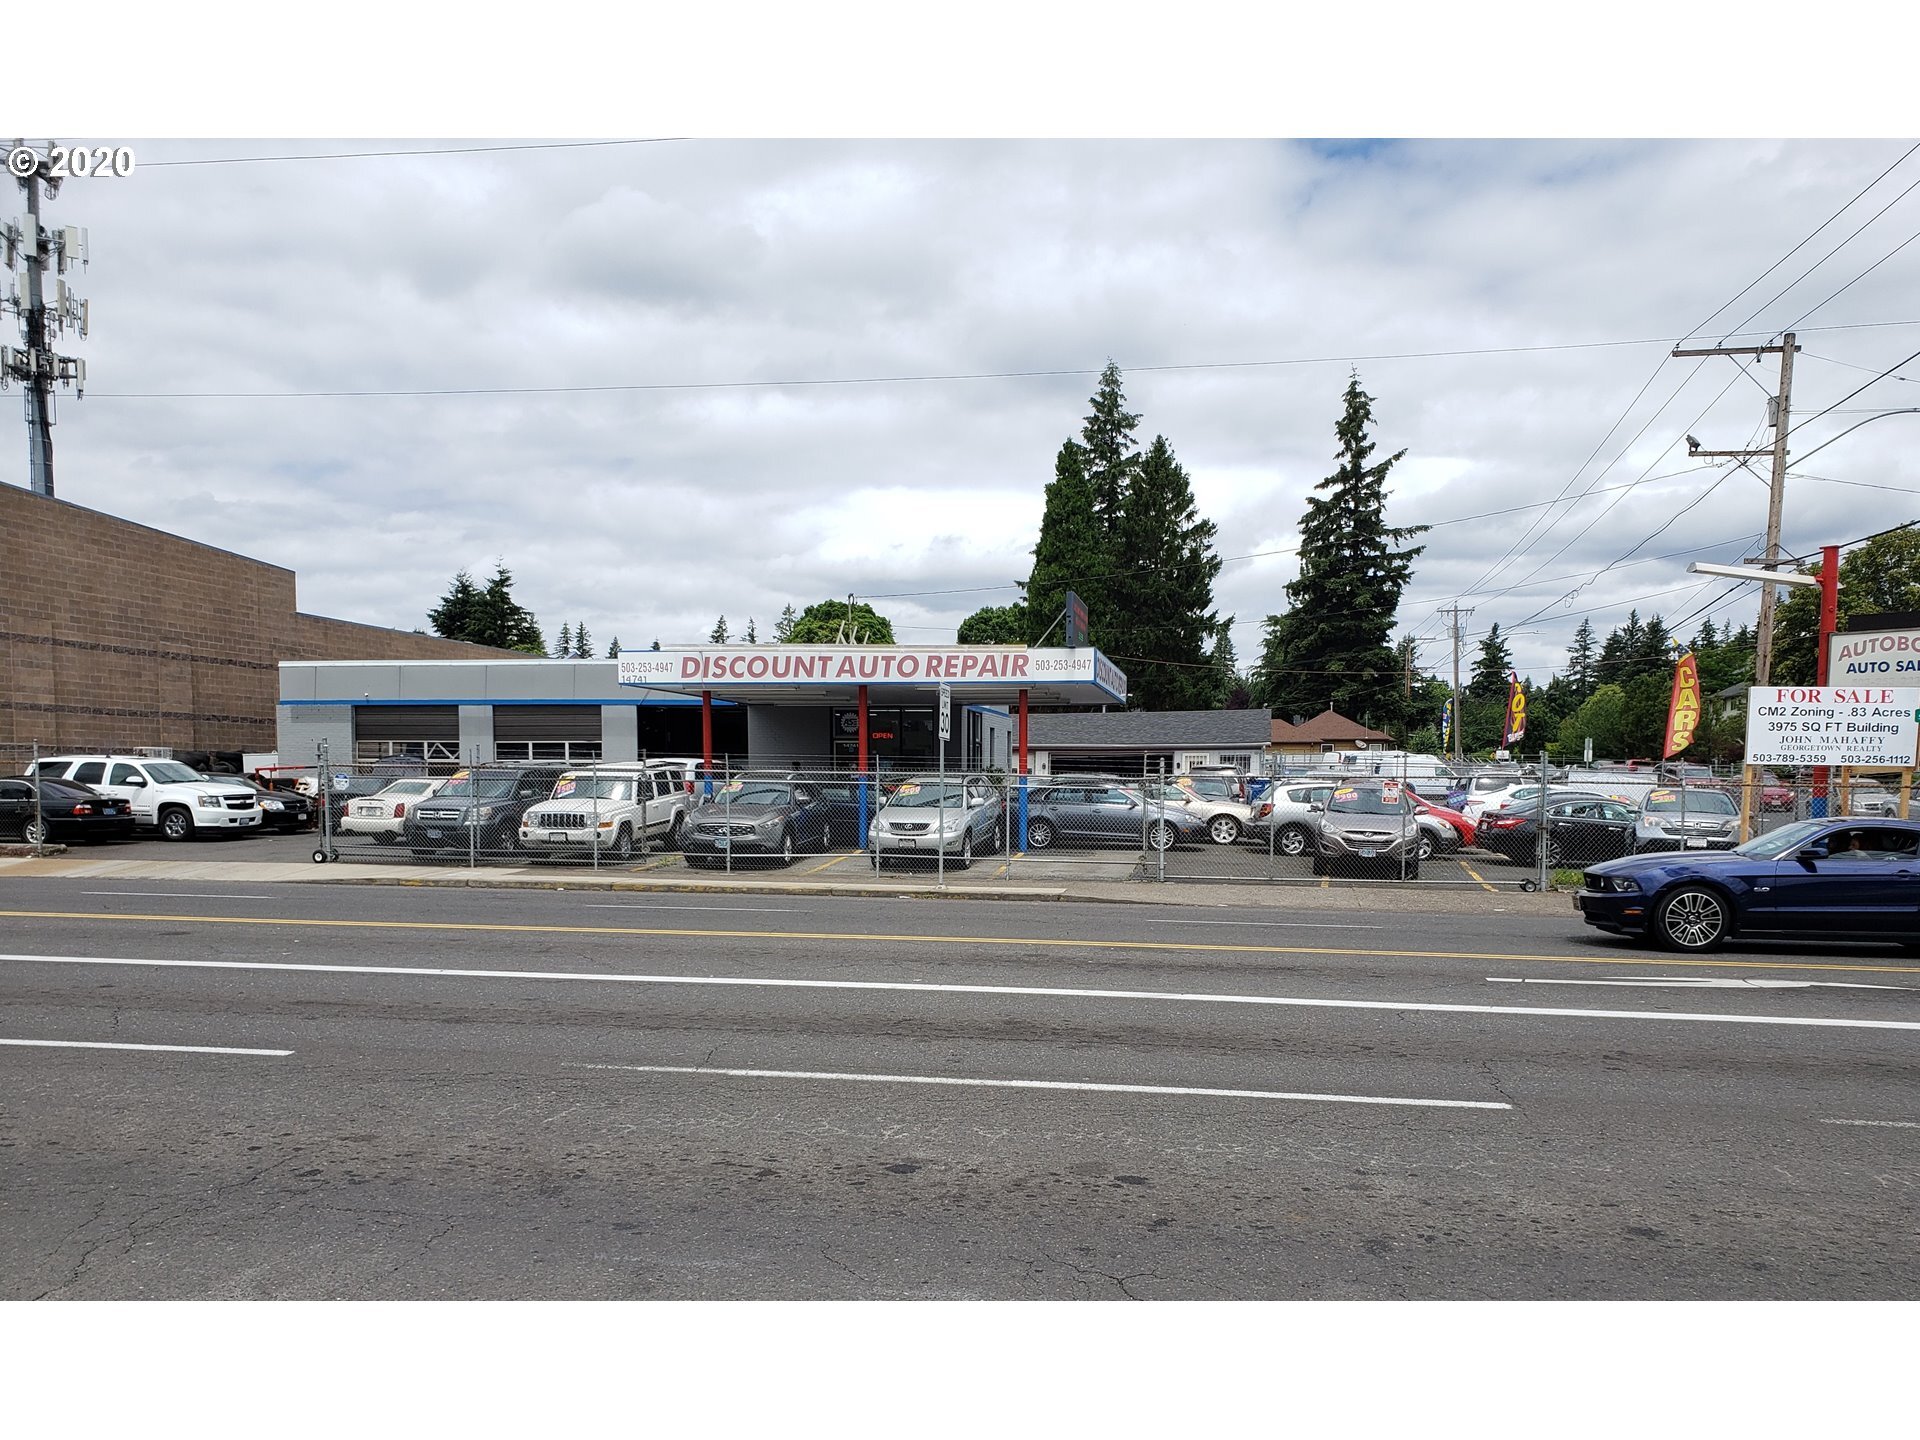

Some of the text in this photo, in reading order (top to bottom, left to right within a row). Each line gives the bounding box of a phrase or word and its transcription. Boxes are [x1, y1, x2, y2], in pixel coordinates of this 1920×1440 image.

[621, 654, 1092, 679] 503-253-4947 DISCOUNT AUTO REPAIR 503-253-4947
[1846, 661, 1890, 674] AUTO
[1776, 688, 1894, 704] FOR SALE
[1671, 666, 1699, 752] CARS
[1758, 706, 1787, 716] CM2
[1790, 706, 1835, 719] Zoning
[1847, 707, 1867, 717] .83
[1871, 707, 1911, 718] Acres
[940, 711, 950, 734] 30
[1768, 721, 1899, 735] 3975 SQ FT Building
[1779, 735, 1886, 745] JOHN MAHAFFY
[1780, 744, 1841, 752] GEORGETOWN
[1752, 753, 1911, 764] 503-789-5359 503-256-1112
